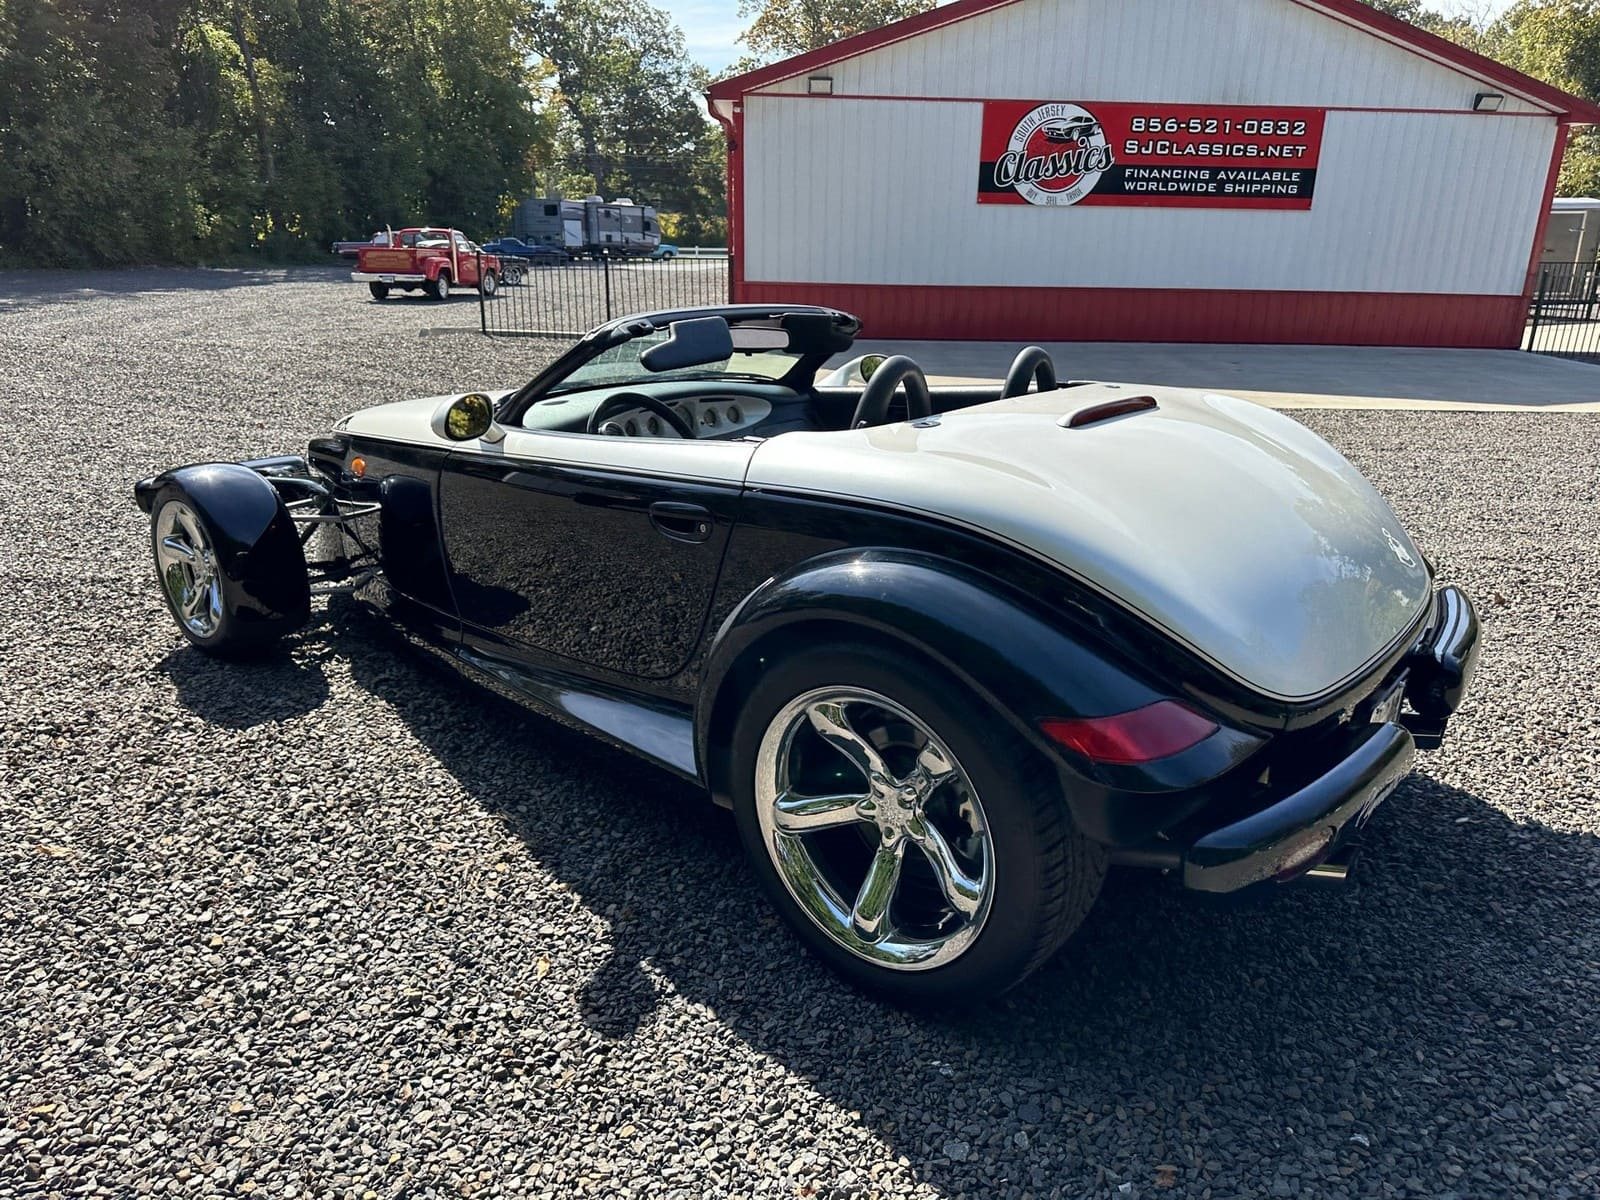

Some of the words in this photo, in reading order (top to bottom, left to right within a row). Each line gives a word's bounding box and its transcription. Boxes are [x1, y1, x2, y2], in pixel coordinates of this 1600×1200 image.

[1014, 117, 1037, 143] SOUTH
[1037, 105, 1066, 122] JERSEY
[1131, 117, 1307, 136] 856-521-0832
[994, 136, 1115, 188] Classics
[1124, 168, 1209, 180] FINANCING
[1216, 170, 1301, 182] AVAILABLE
[1025, 187, 1038, 200] BUY
[1066, 187, 1084, 201] TRADE
[1124, 181, 1216, 193] WORLDWIDE
[1223, 183, 1298, 194] SHIPPING
